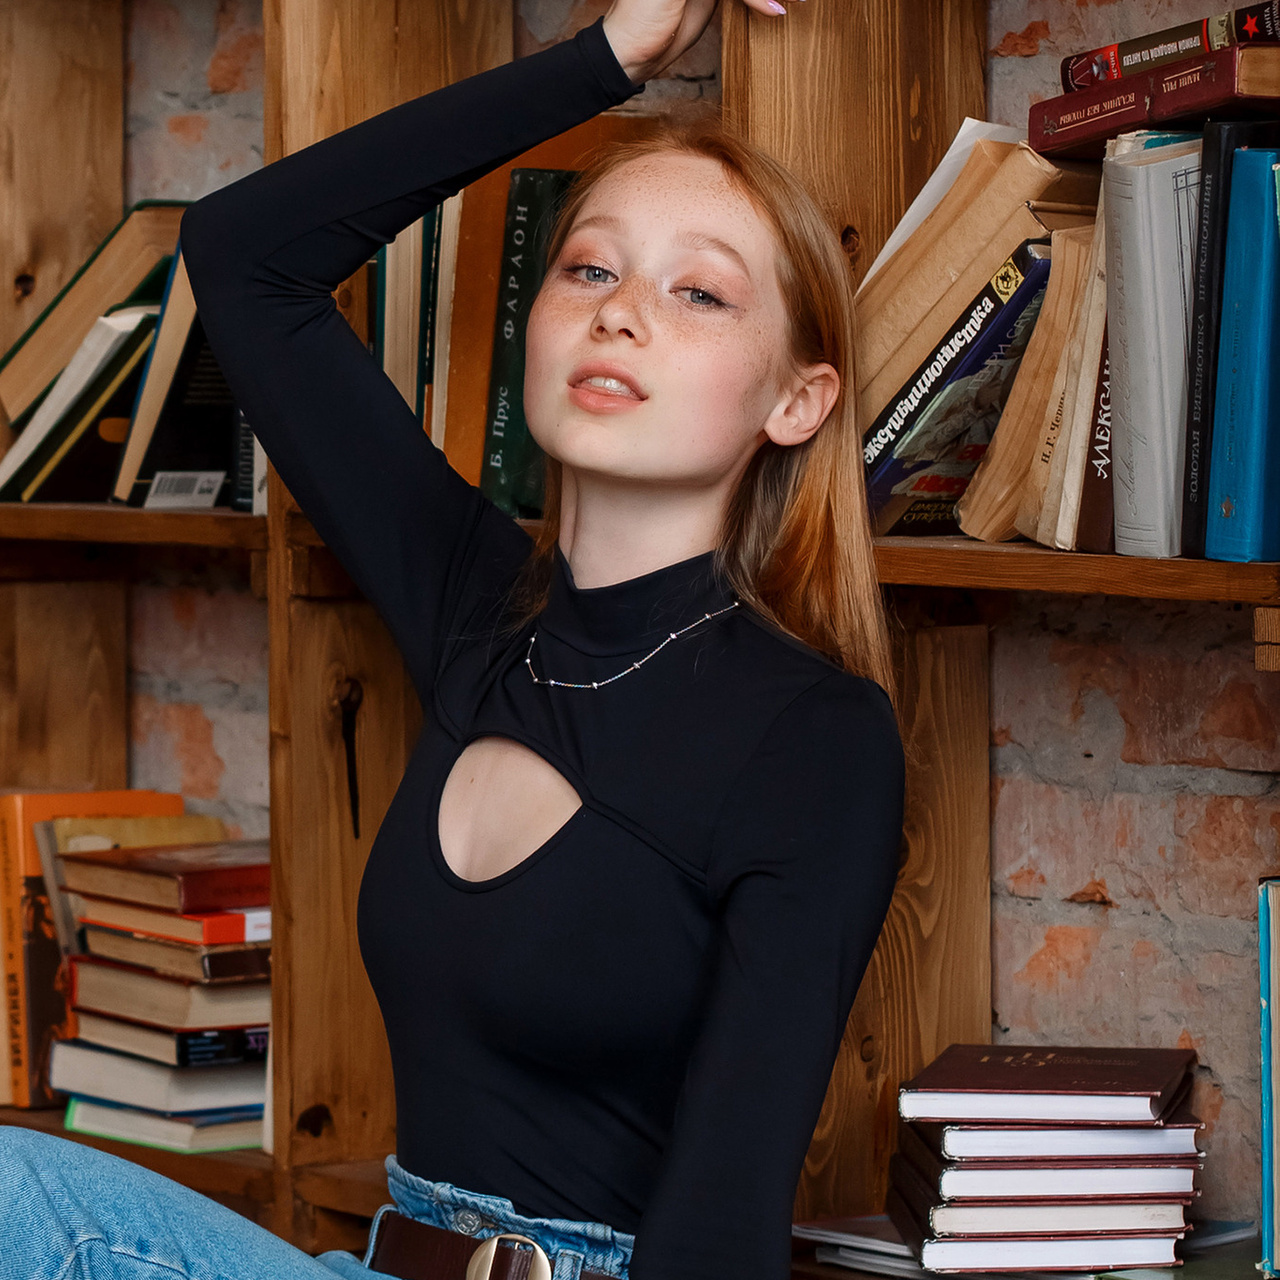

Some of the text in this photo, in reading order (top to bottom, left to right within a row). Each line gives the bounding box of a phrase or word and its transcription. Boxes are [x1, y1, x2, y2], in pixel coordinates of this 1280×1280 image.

[1059, 92, 1136, 126] ВСАДНИК БЕЗ ГОЛОВЫ
[503, 205, 528, 340] ФАРАОН
[1192, 312, 1207, 422] БИБЛИОТЕКА
[490, 385, 509, 469] Б. Прус
[1041, 452, 1050, 464] Н.
[1189, 431, 1201, 505] ЗОЛОТАЯ
